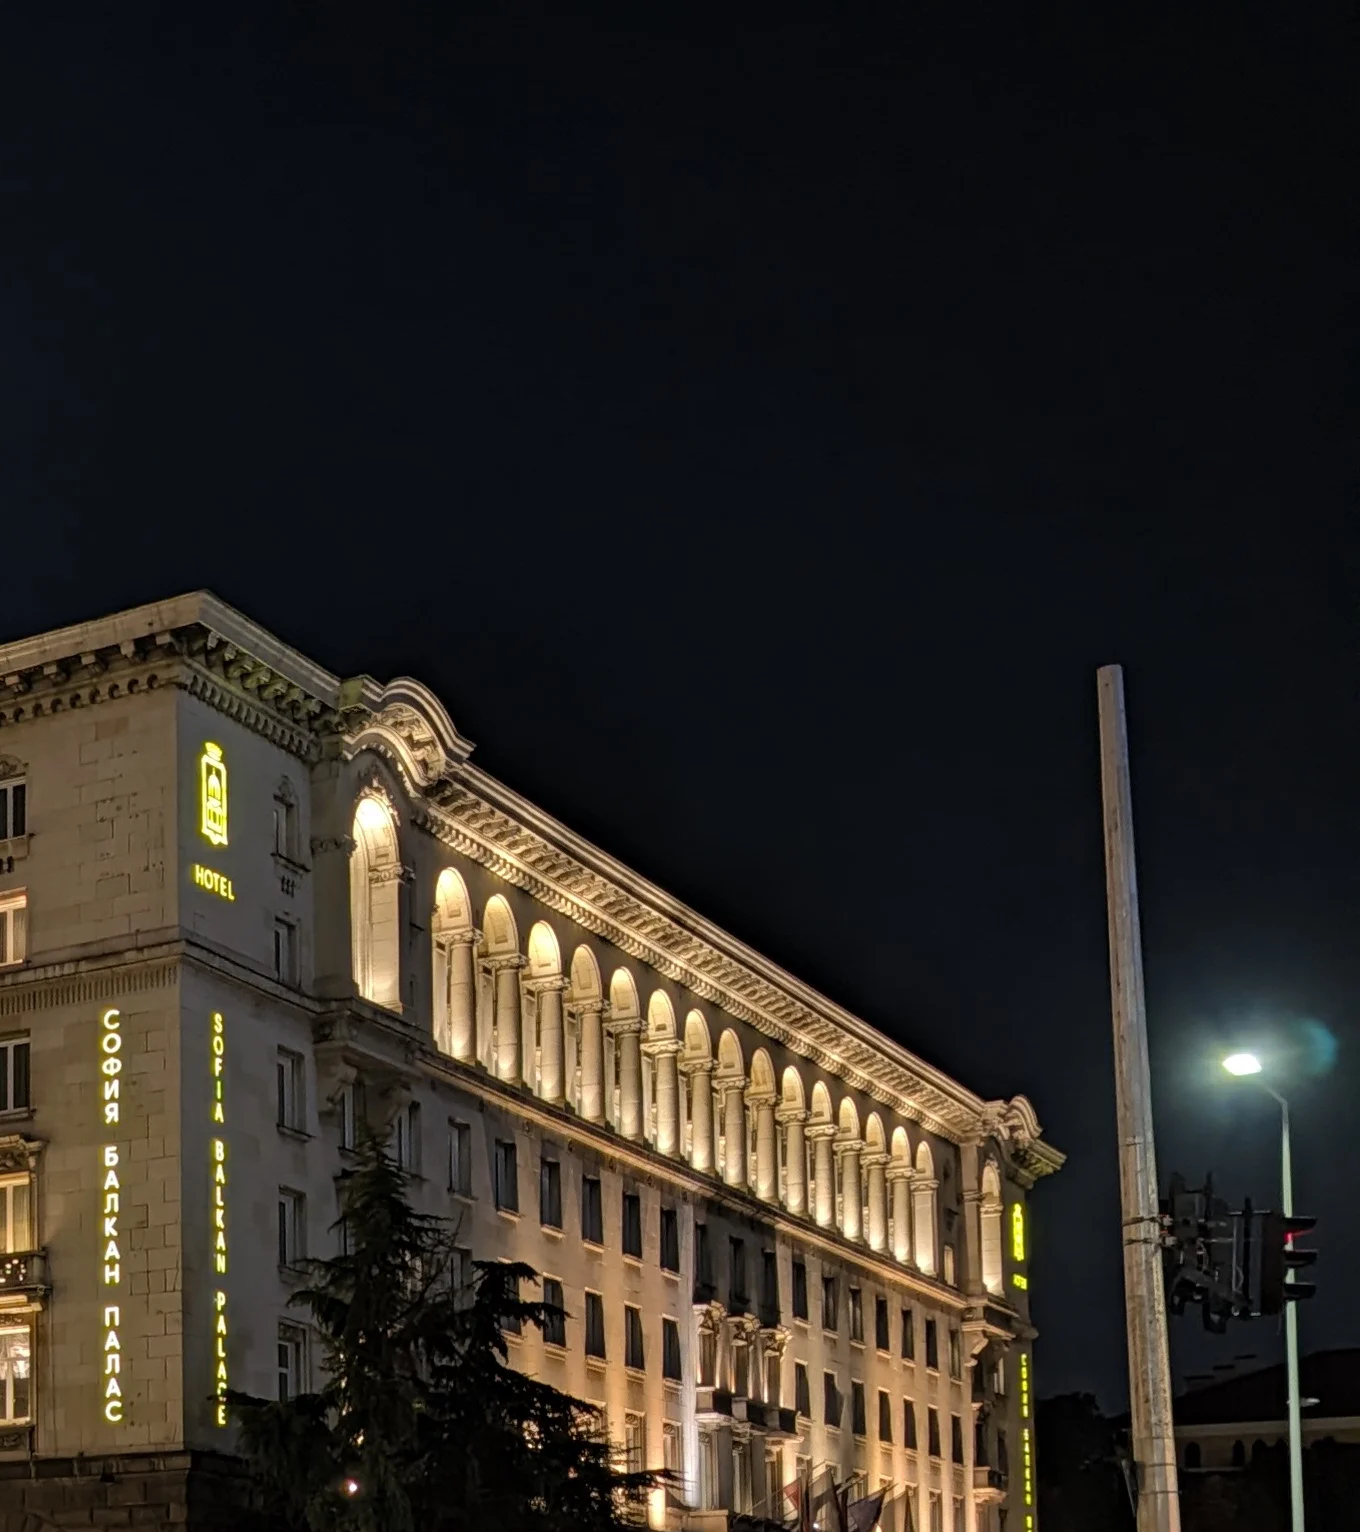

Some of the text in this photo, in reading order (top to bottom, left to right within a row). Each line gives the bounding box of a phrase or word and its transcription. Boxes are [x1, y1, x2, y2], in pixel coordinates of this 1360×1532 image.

[195, 864, 235, 900] HOTEL
[213, 1013, 224, 1123] SOFIA
[102, 1009, 122, 1421] СОФИЯ БАЛКАН ПАЛАС
[215, 1138, 226, 1274] BALKAN
